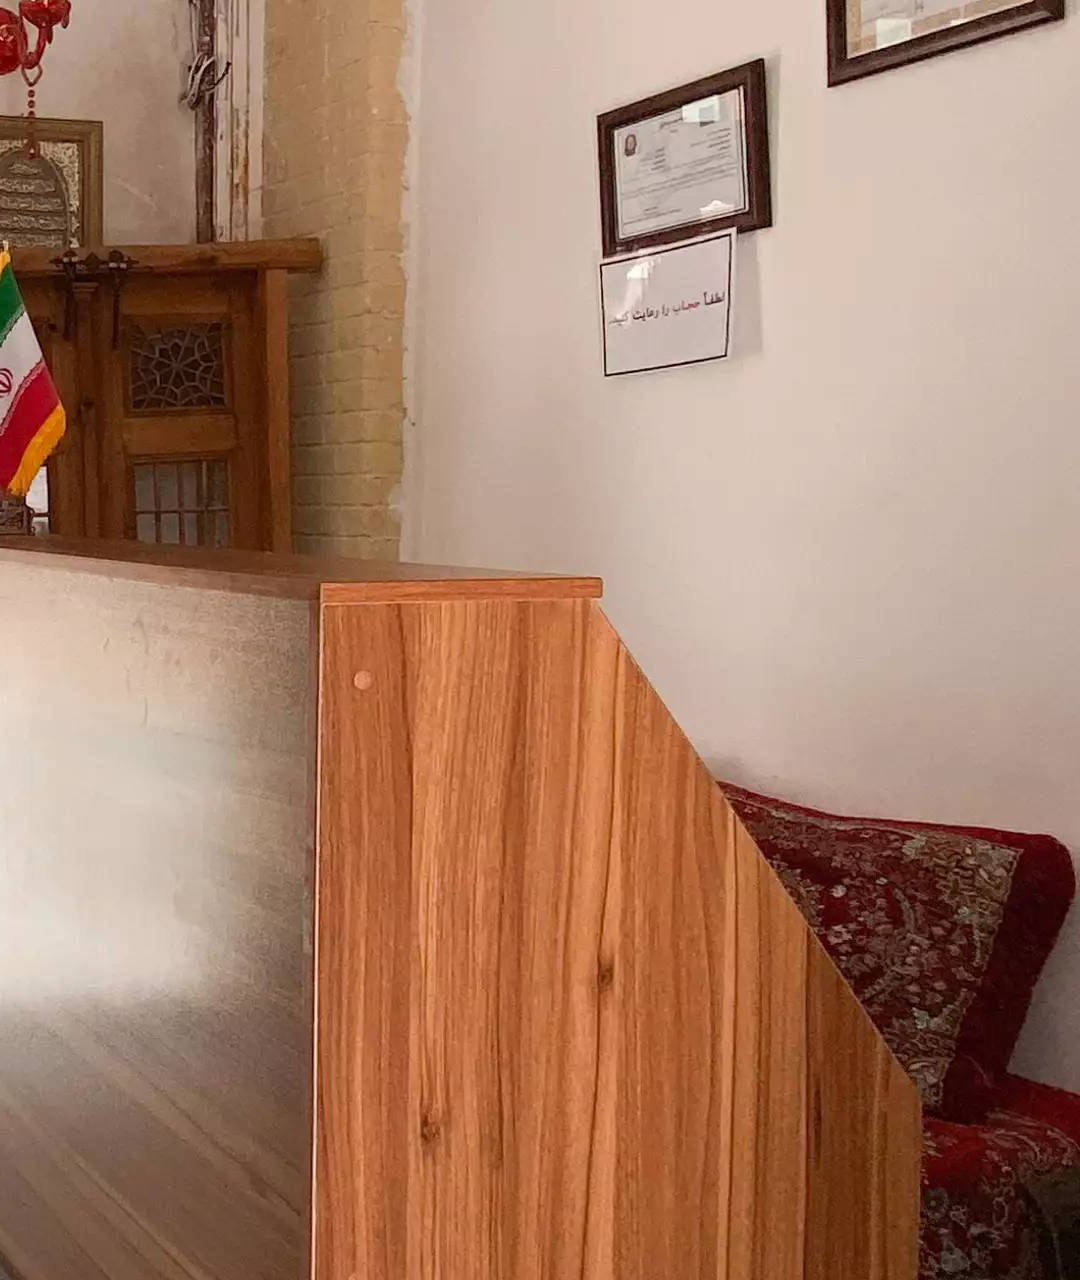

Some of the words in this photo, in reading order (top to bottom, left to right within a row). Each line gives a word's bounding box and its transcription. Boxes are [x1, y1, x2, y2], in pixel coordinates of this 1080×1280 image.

[632, 307, 659, 322] رعایت
[661, 304, 670, 316] را
[672, 300, 700, 315] حجاب
